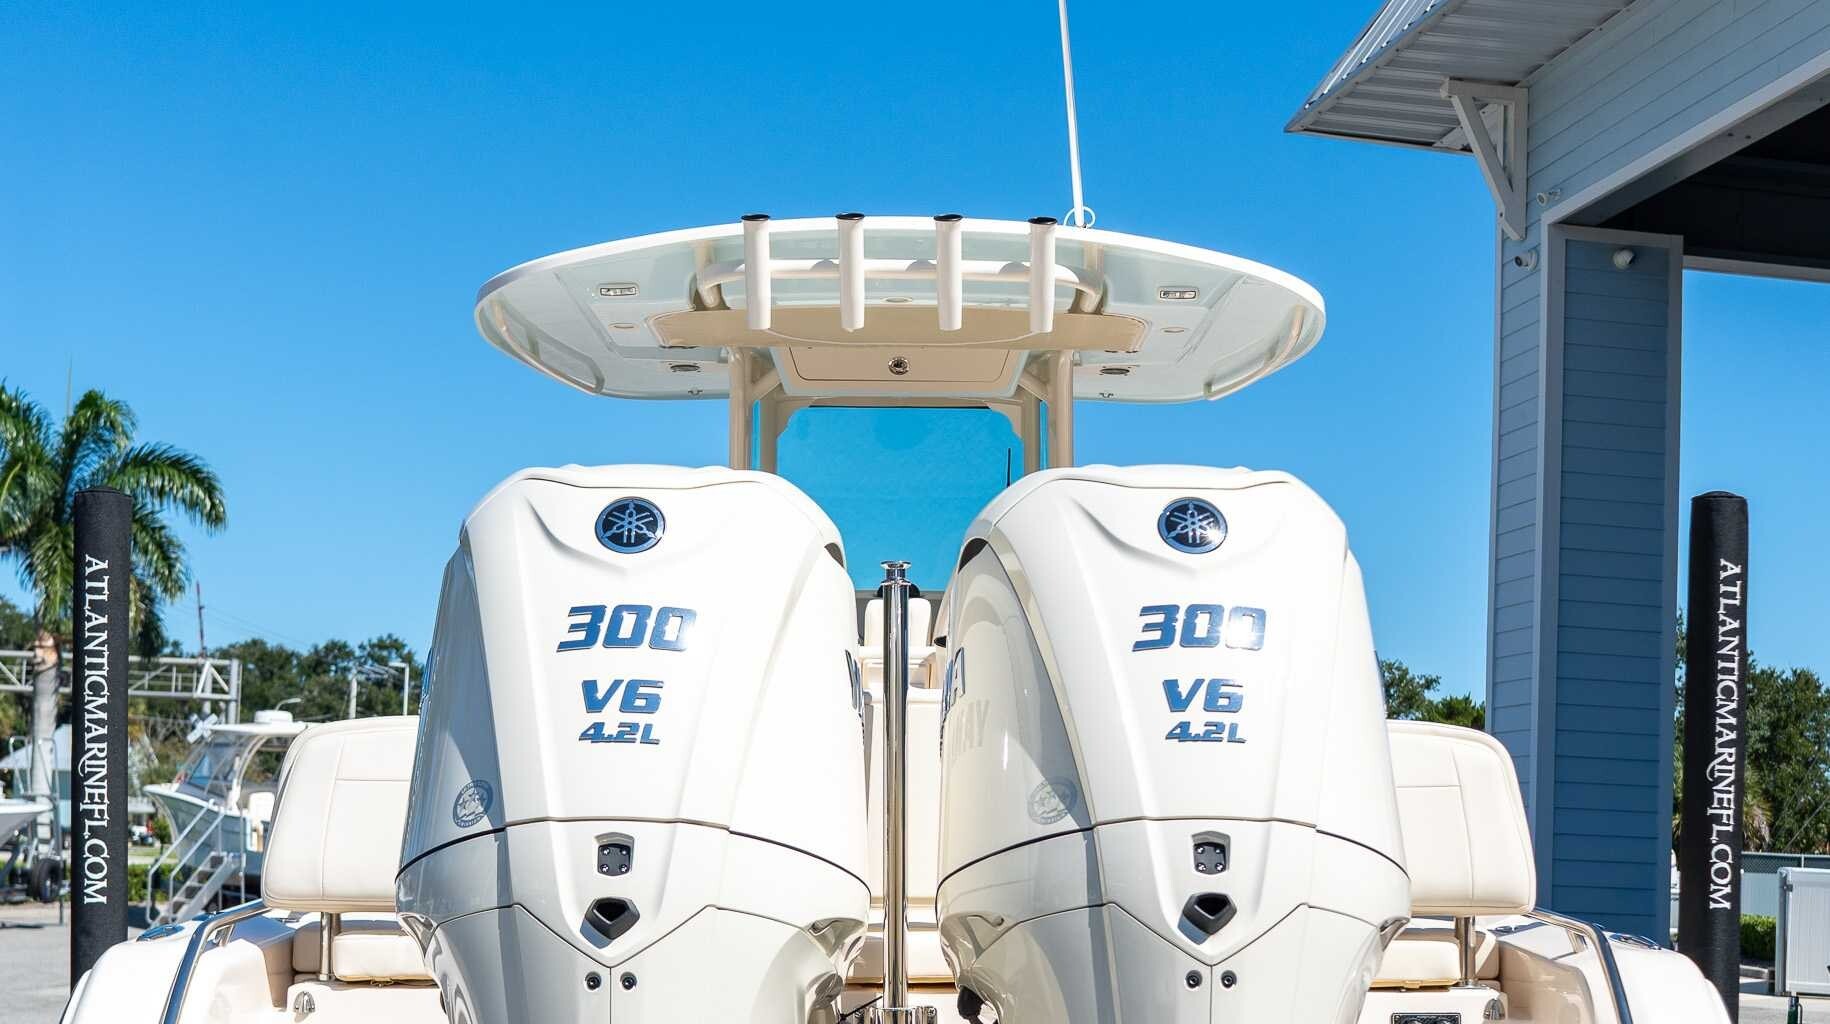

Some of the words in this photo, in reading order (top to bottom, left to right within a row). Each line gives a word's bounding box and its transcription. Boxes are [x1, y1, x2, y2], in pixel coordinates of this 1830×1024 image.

[556, 604, 697, 652] 300
[1132, 604, 1267, 651] 300
[581, 679, 664, 714] V6
[1162, 678, 1244, 713] V6
[78, 553, 111, 904] ATLANTICMARINEFL.COM
[578, 722, 661, 745] 4.2L
[1165, 721, 1247, 743] 4.2L
[1706, 558, 1742, 910] ATLANTICMARINEFL.COM
